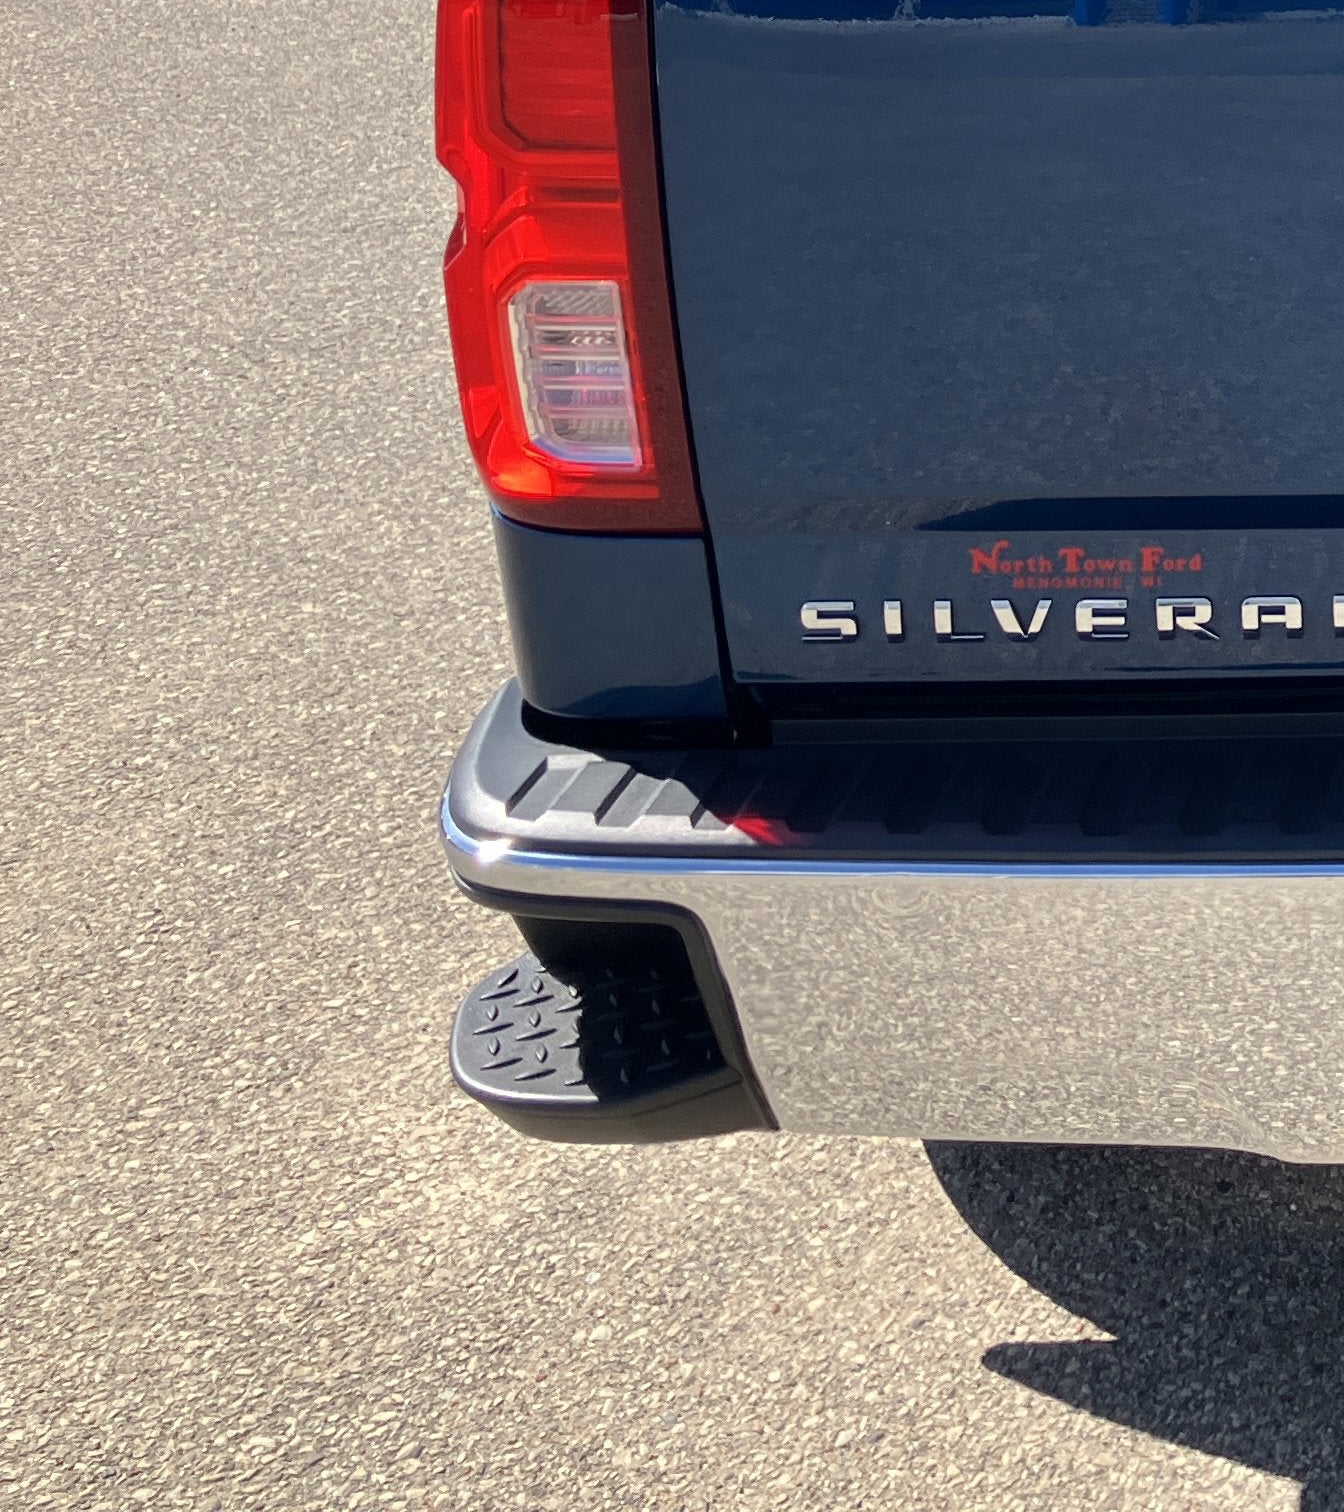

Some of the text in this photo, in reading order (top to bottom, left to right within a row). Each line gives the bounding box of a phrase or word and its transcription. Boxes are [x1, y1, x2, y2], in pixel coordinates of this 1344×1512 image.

[969, 539, 1204, 574] North Town Ford
